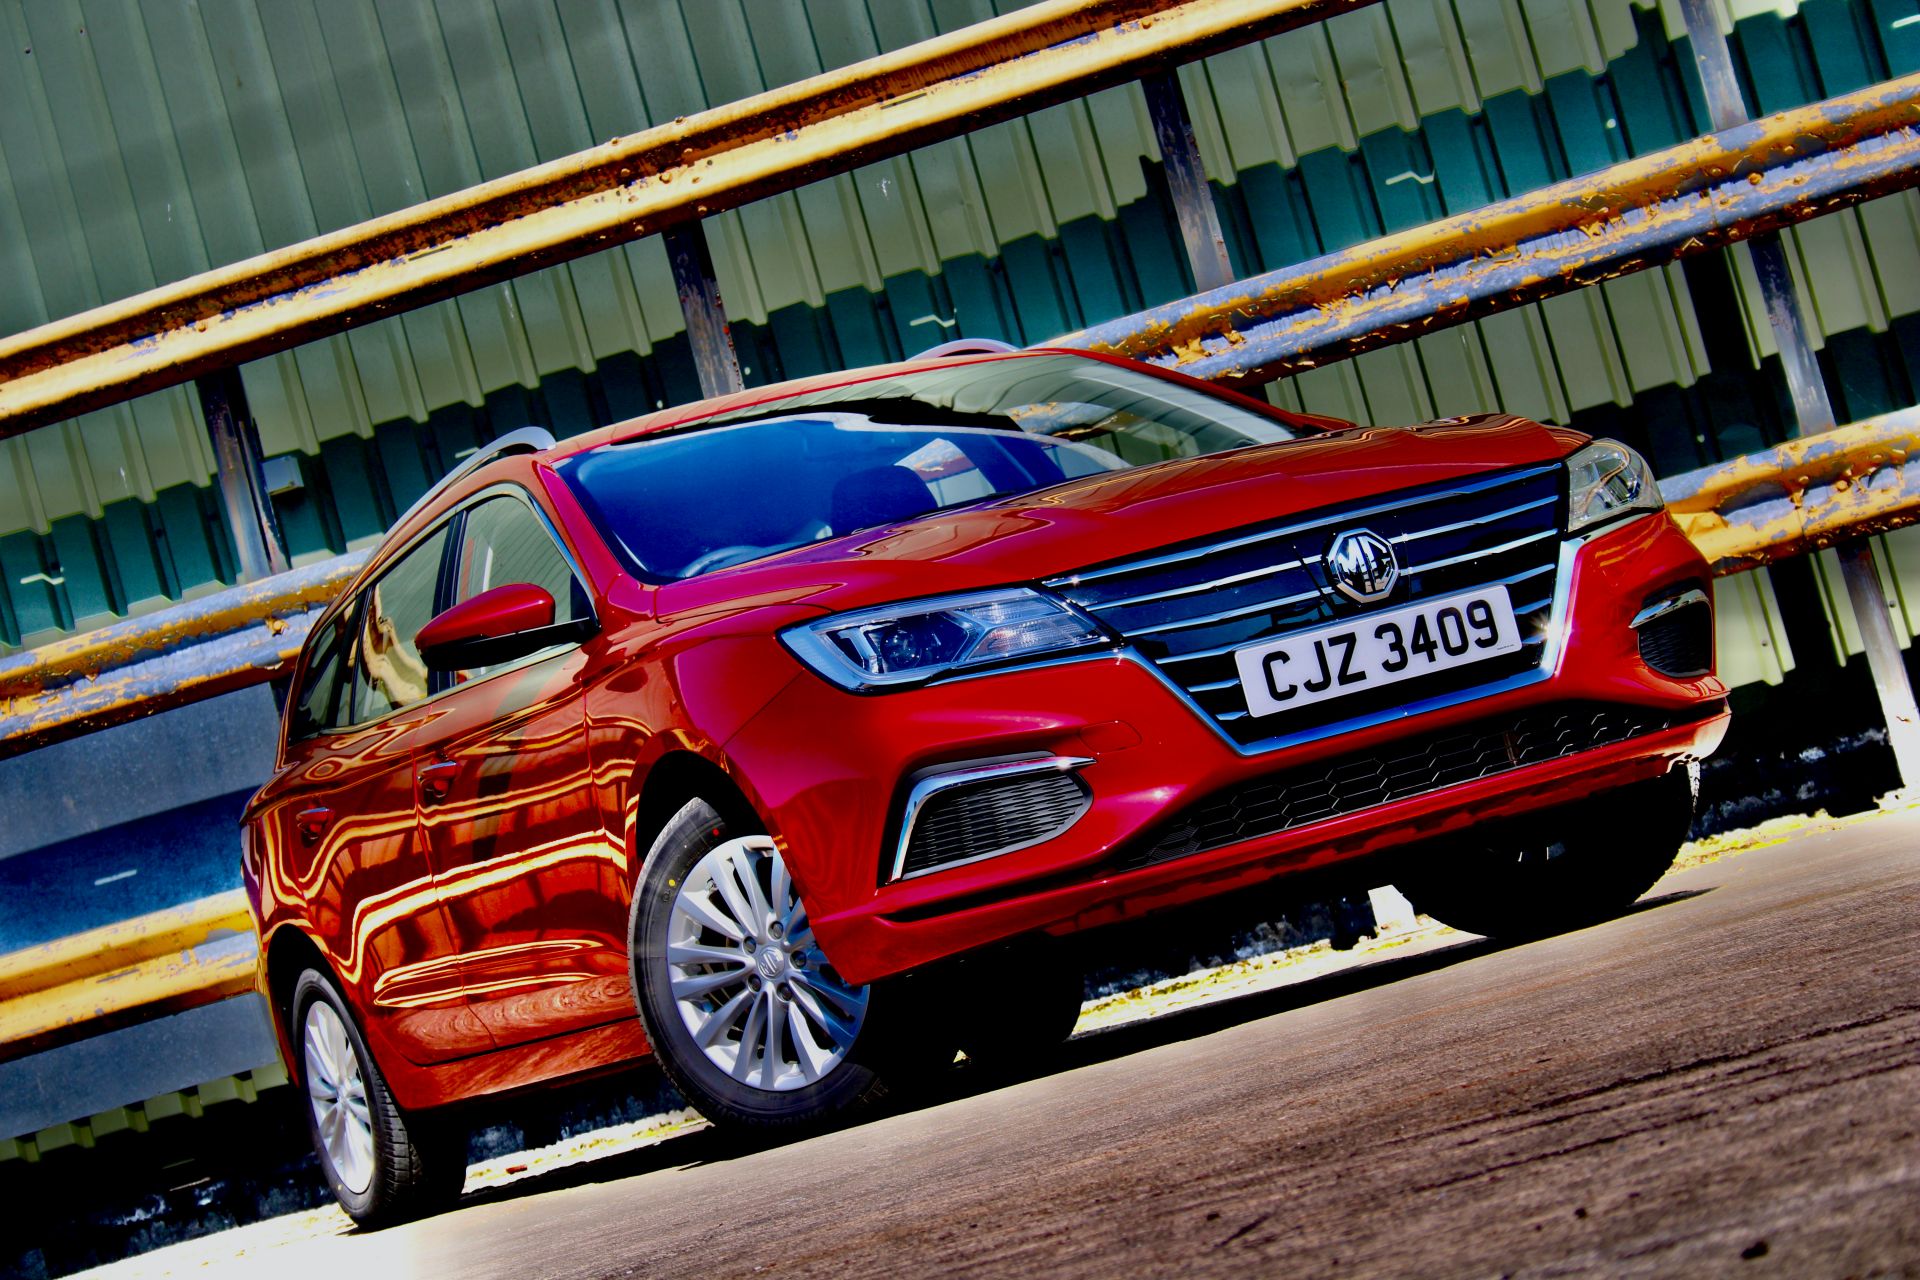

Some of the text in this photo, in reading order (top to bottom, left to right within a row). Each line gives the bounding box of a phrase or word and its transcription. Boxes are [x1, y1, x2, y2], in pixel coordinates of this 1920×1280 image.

[1337, 535, 1393, 593] MG
[1262, 599, 1499, 701] CJZ 3409
